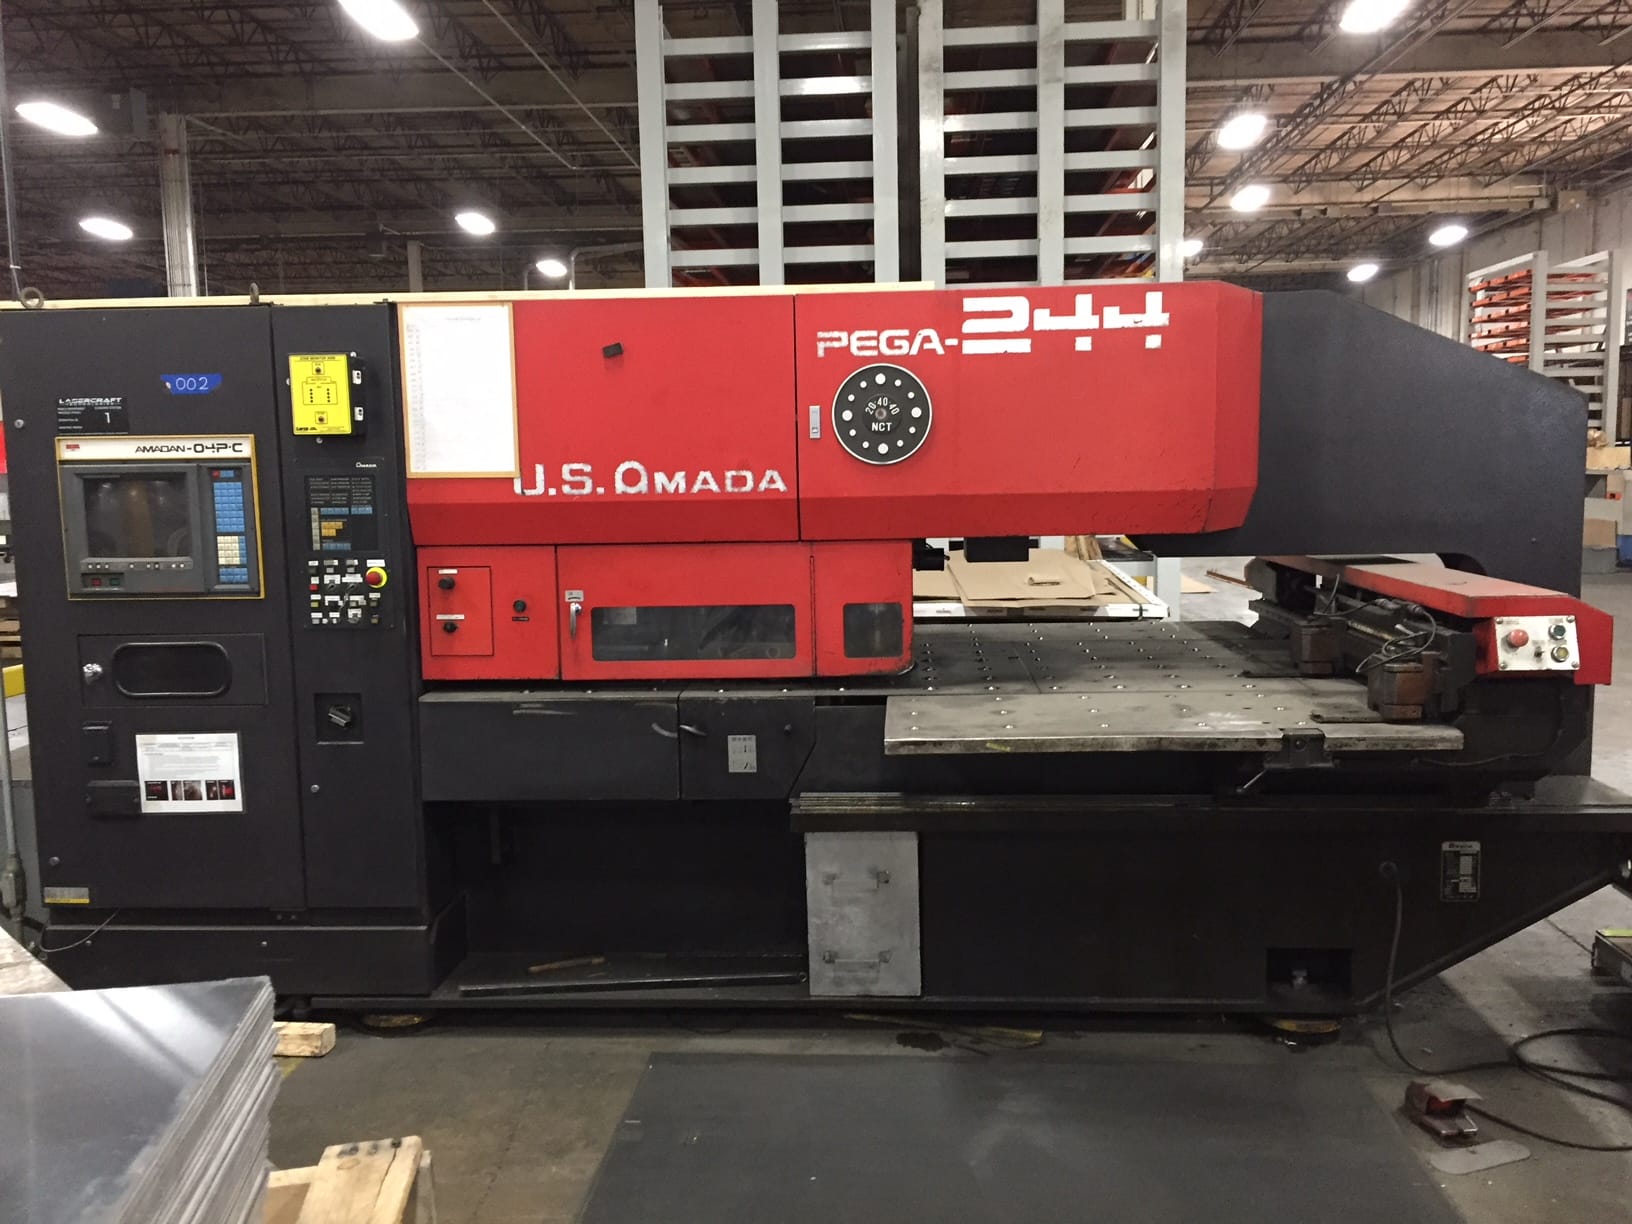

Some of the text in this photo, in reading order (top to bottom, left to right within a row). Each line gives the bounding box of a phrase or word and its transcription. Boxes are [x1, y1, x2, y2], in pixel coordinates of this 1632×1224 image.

[817, 291, 1170, 358] PEGA-244
[175, 376, 209, 391] 002
[872, 422, 892, 431] NCT
[513, 463, 605, 496] U.S.
